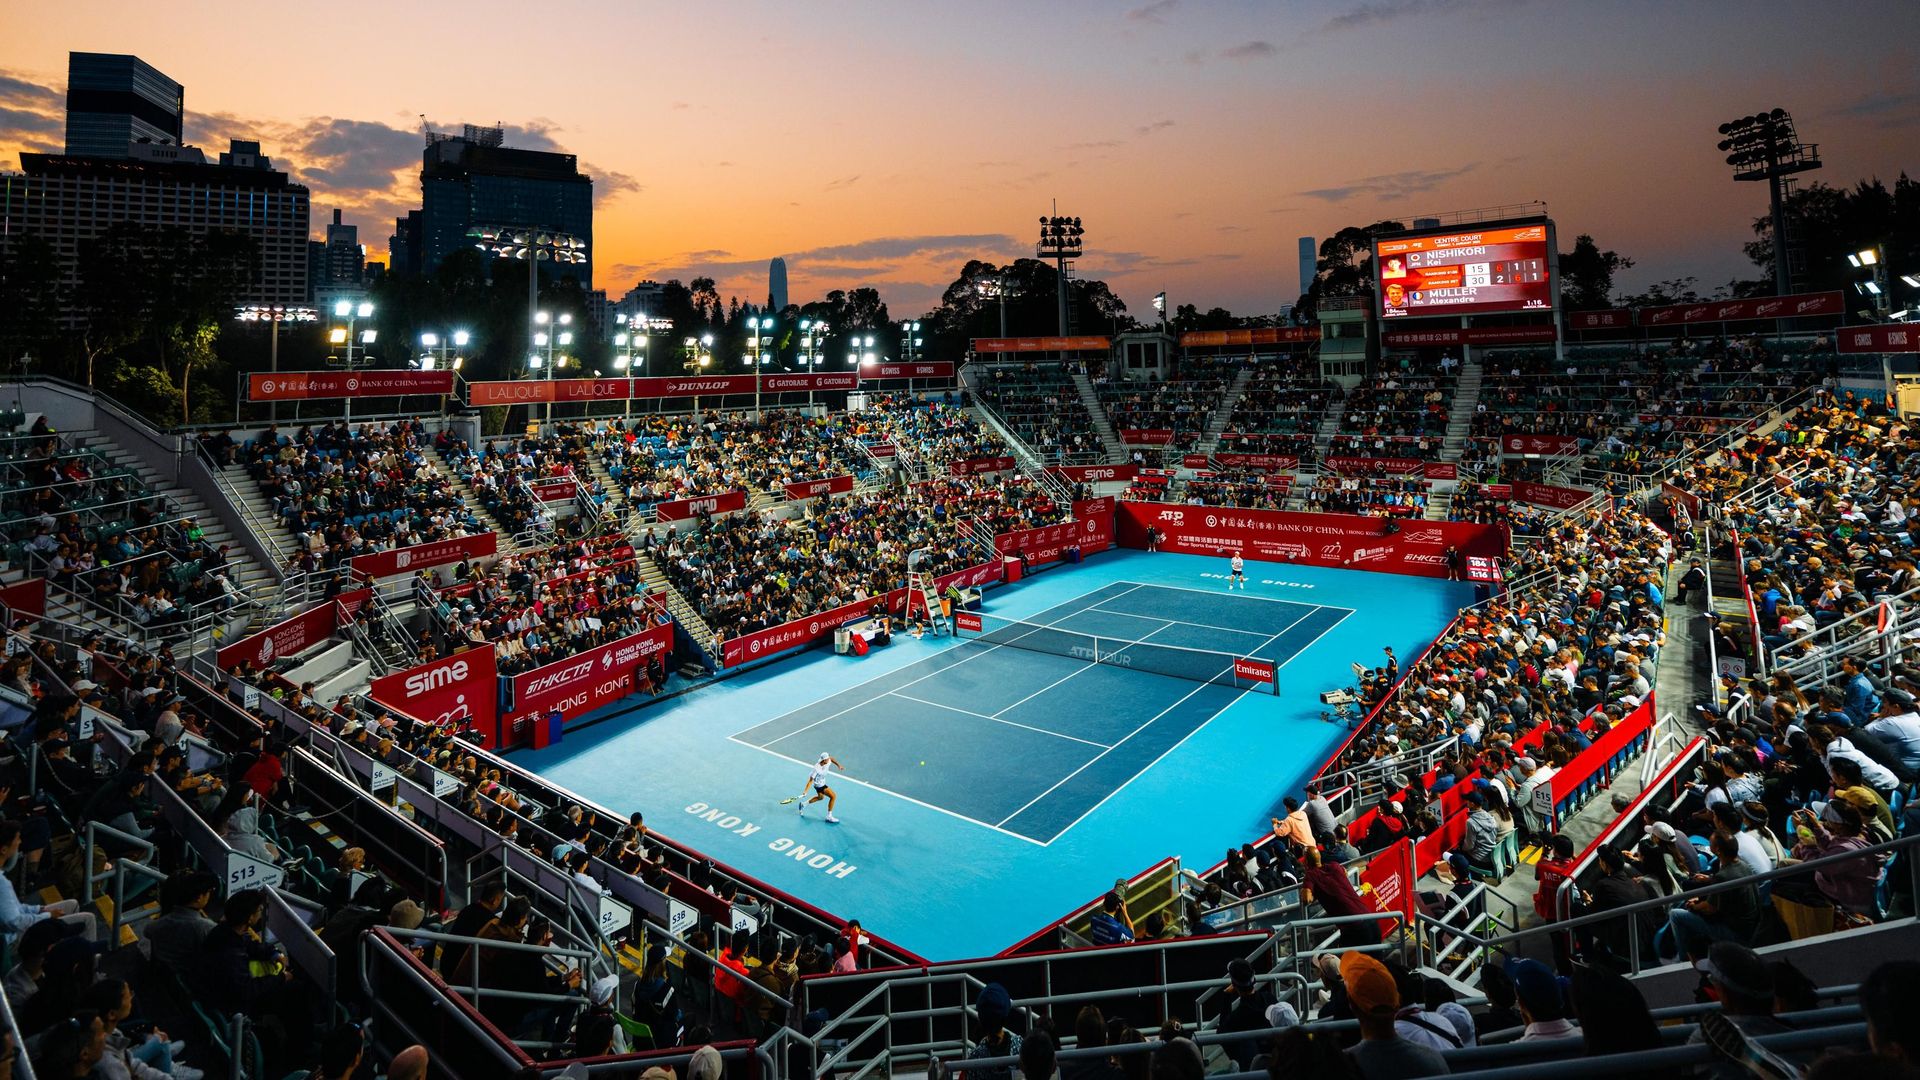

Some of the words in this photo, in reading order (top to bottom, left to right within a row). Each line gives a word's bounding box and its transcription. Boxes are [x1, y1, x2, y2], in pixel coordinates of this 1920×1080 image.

[1434, 236, 1460, 245] CENTRE
[1460, 234, 1482, 242] COURT
[1426, 246, 1486, 259] NISHIKORI
[1427, 258, 1441, 266] Kei
[1514, 262, 1519, 270] 1
[1472, 265, 1484, 273] 15
[1496, 264, 1502, 272] 6
[1514, 274, 1521, 282] 6
[1532, 272, 1538, 280] 1
[1429, 288, 1477, 298] MULLER
[1430, 296, 1474, 305] Alexandre
[1586, 314, 1614, 326] 香港
[362, 380, 382, 388] BANK
[384, 380, 393, 388] OF
[394, 379, 418, 387] CHINA
[677, 381, 730, 392] DUNLOP
[776, 379, 808, 387] GATORADE
[824, 378, 852, 386] GATORADE
[488, 386, 542, 400] LALIQUE
[569, 384, 616, 397] LALIQUE
[1158, 510, 1184, 521] ATP
[1277, 523, 1300, 532] BANK
[1302, 525, 1314, 533] OF
[1316, 526, 1344, 535] CHINA
[1038, 548, 1058, 558] KONG
[1470, 560, 1487, 568] 184
[1261, 579, 1315, 589] HONG
[820, 619, 835, 629] BANK
[836, 616, 844, 624] OF
[844, 611, 861, 621] CHINA
[958, 617, 980, 628] Emirates
[274, 627, 290, 640] HONG
[291, 622, 305, 632] KONG
[616, 644, 635, 657] HONG
[636, 638, 654, 651] KONG
[616, 653, 639, 666] TENNIS
[640, 641, 666, 656] SEASON
[1097, 650, 1131, 666] TOUR
[538, 660, 594, 688] HKCTA
[1236, 664, 1271, 678] Emirates
[550, 691, 587, 712] HONG
[595, 674, 629, 698] KONG
[374, 771, 382, 779] S6
[436, 779, 444, 787] S6
[1535, 791, 1550, 801] E15
[1428, 806, 1442, 816] E14
[684, 802, 761, 838] KONG
[768, 837, 857, 879] HONG
[231, 865, 255, 884] S13
[262, 873, 277, 882] China
[602, 912, 612, 924] S2
[672, 910, 686, 924] S3B
[734, 919, 747, 932] S3A
